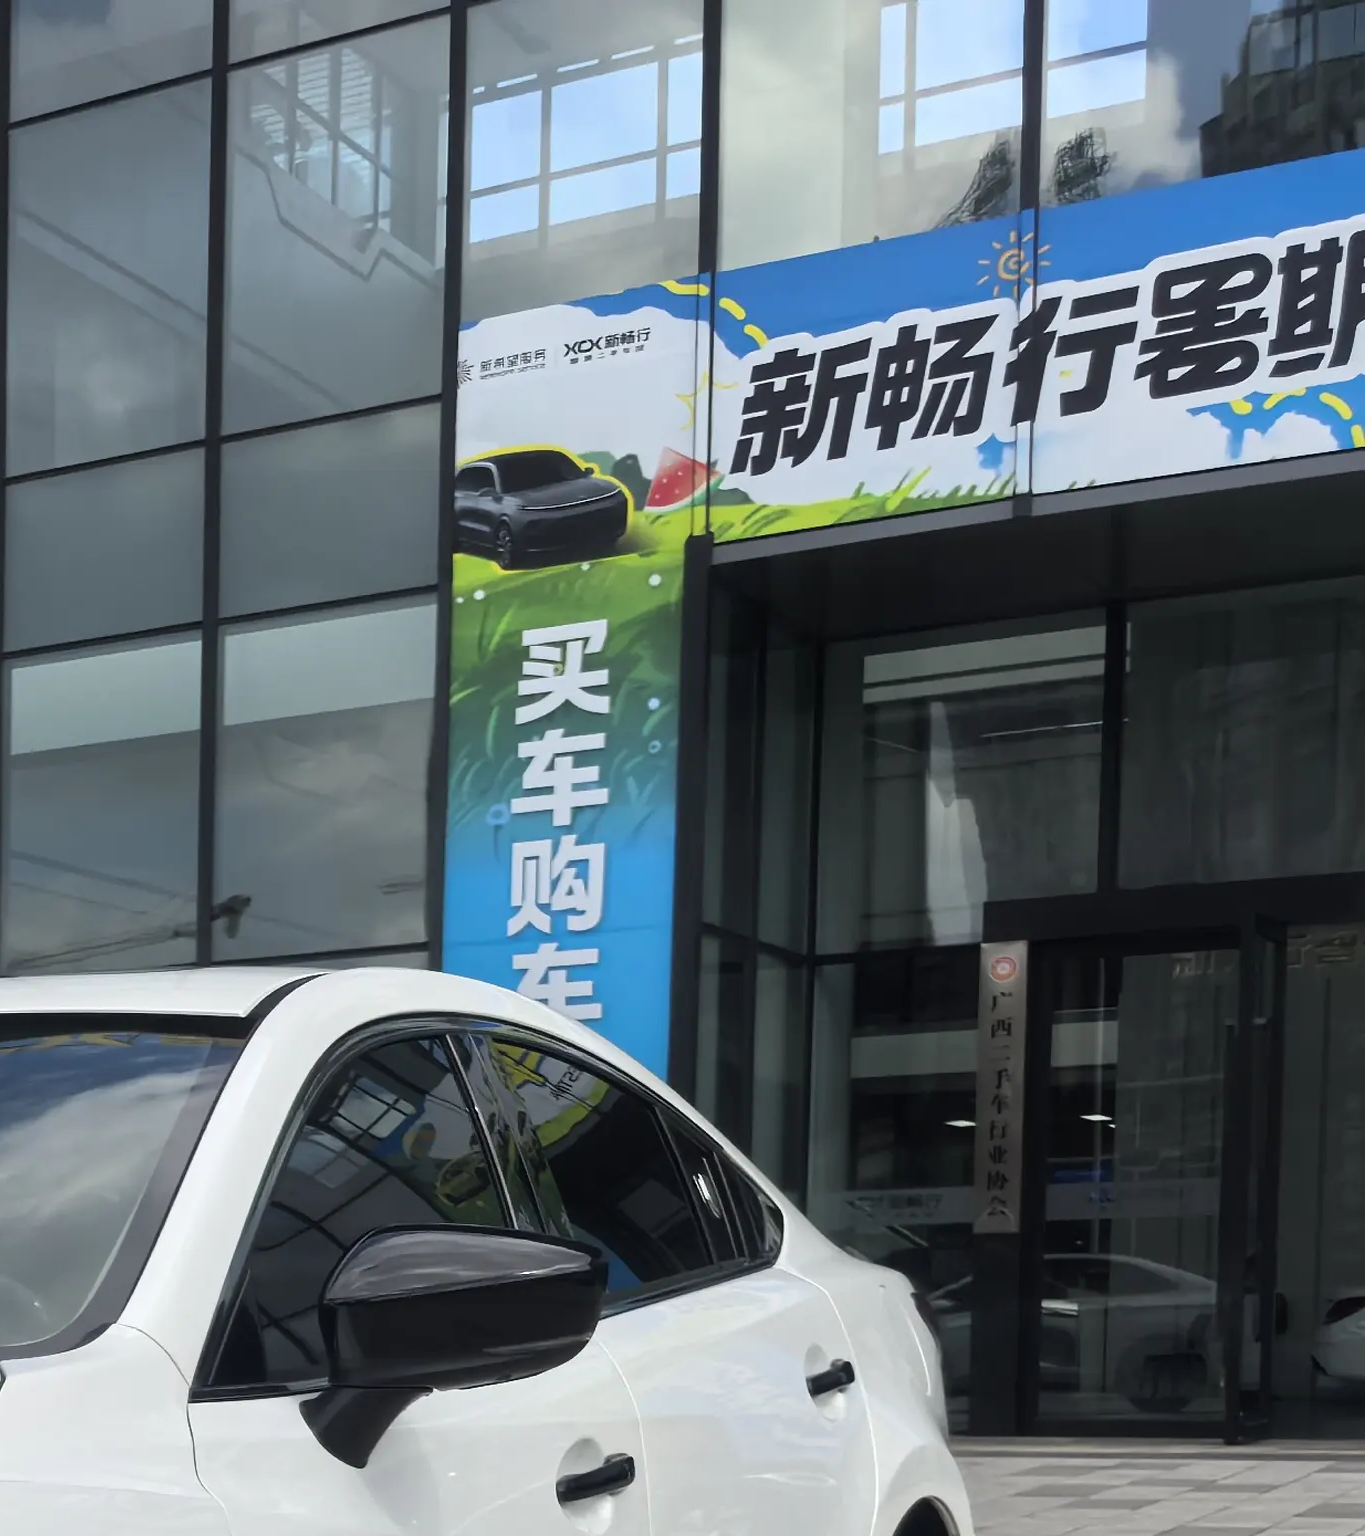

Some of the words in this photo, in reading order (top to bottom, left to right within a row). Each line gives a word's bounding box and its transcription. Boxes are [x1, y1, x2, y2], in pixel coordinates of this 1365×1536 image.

[729, 229, 1365, 476] 新畅行暑期
[507, 618, 610, 1023] 买车购车
